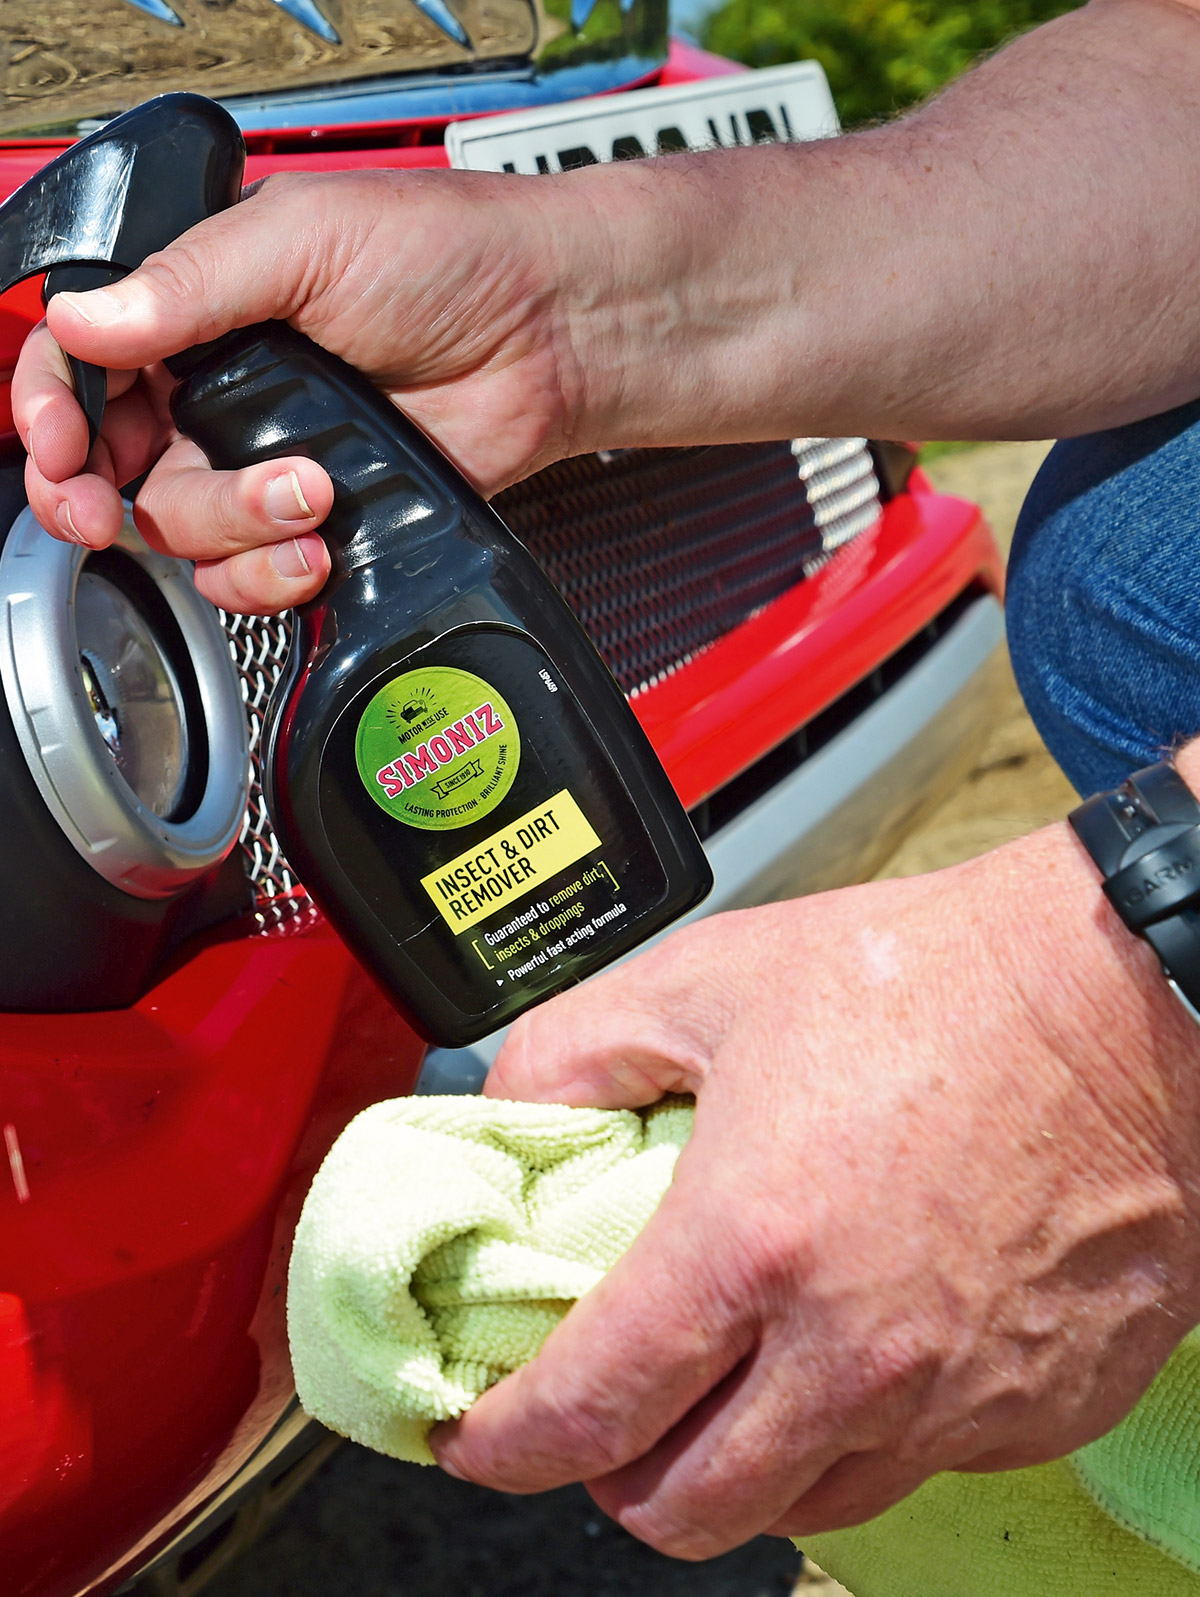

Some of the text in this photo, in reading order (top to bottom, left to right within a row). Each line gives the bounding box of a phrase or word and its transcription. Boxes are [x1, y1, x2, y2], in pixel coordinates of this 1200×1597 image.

[376, 701, 505, 799] SIMONIZ
[398, 707, 449, 744] MOTOR WISE USE
[404, 802, 434, 818] LASTING
[436, 798, 478, 818] PROTECTION
[480, 766, 504, 799] BRILLIANT
[498, 744, 507, 765] SHINE
[445, 776, 461, 788] SINCE
[435, 810, 560, 900] INSECT & DIRT
[449, 857, 537, 920] REMOVER
[484, 867, 604, 946] Guaranteed to remove dirt,
[494, 901, 585, 962] insects & droppings
[507, 902, 627, 981] Powerful fast acting formula
